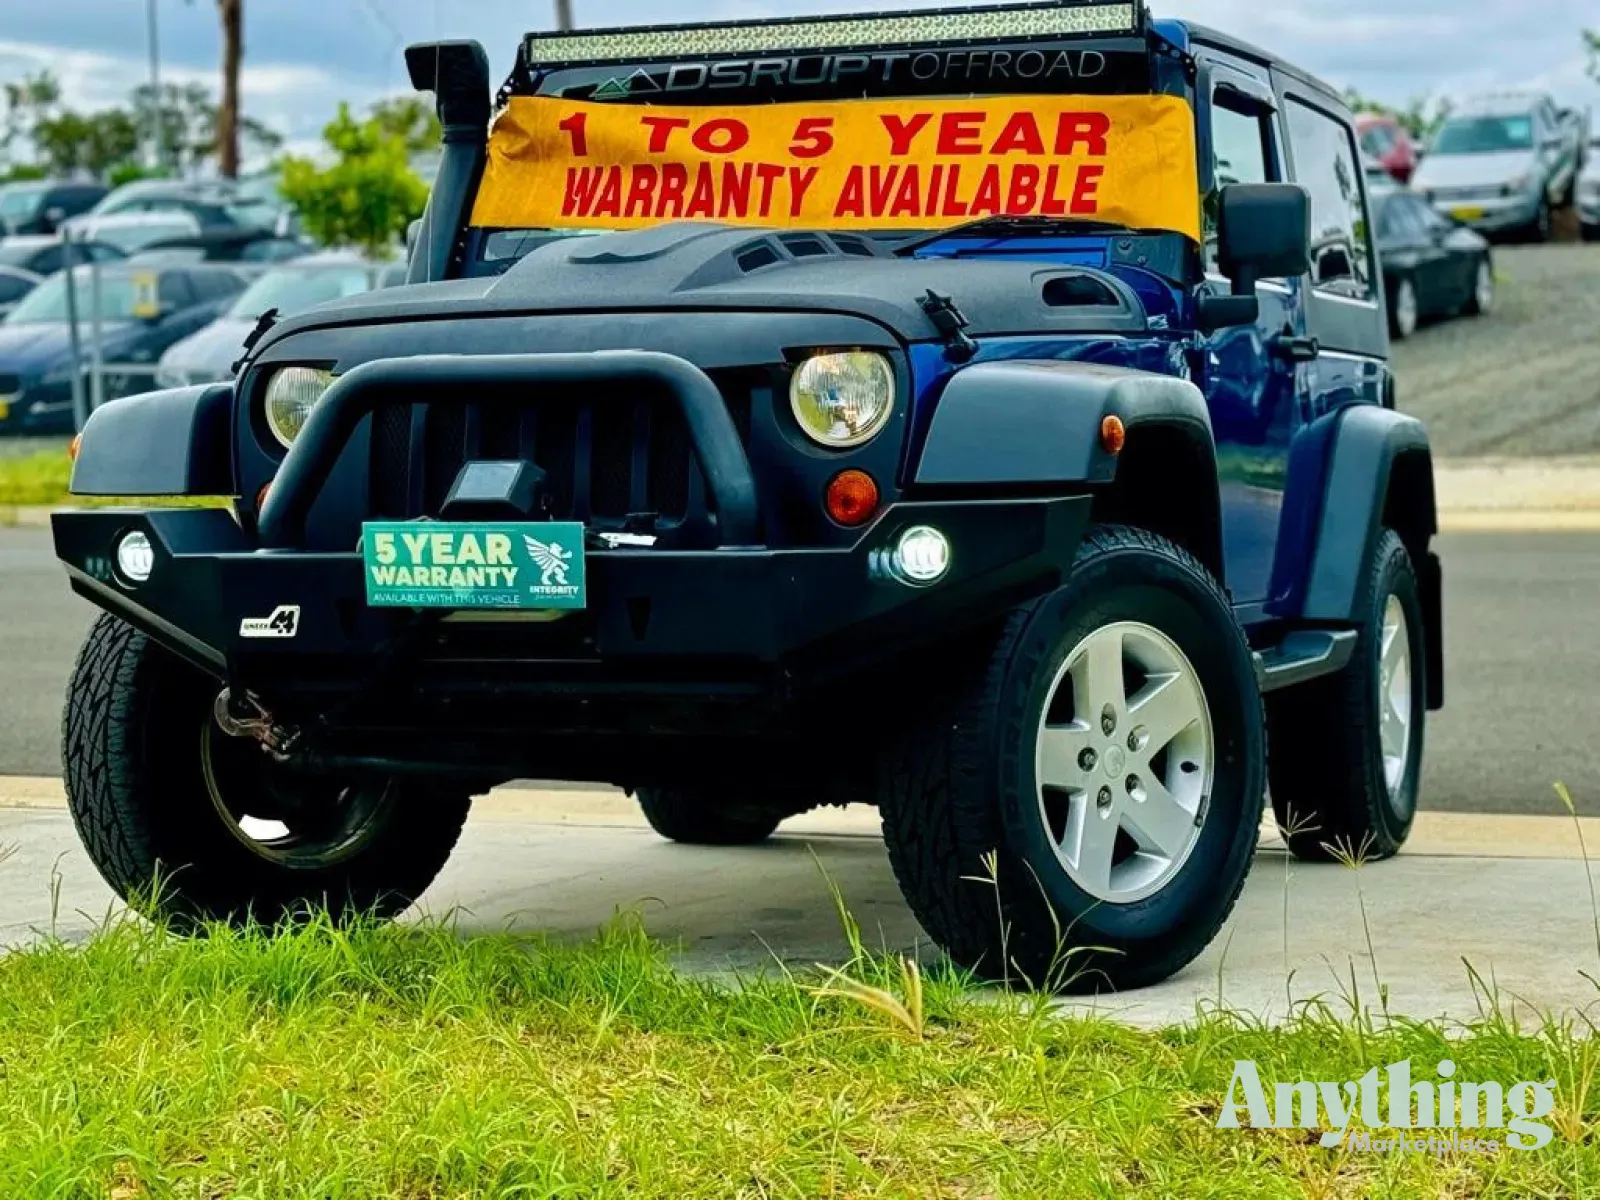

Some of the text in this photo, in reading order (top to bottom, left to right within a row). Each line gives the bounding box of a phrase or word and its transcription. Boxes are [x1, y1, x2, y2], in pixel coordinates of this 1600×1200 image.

[911, 50, 1106, 79] OFFROAD
[559, 111, 1112, 158] 1 TO 5 YEAR
[561, 162, 1104, 218] WARRANTY AVAILABLE
[374, 532, 513, 565] 5 YEAR
[371, 566, 519, 587] WARRANTY
[529, 585, 579, 595] INTEGRITY
[374, 593, 425, 604] AVAILABLE
[426, 594, 453, 605] WITH
[477, 594, 521, 605] VEHICLE
